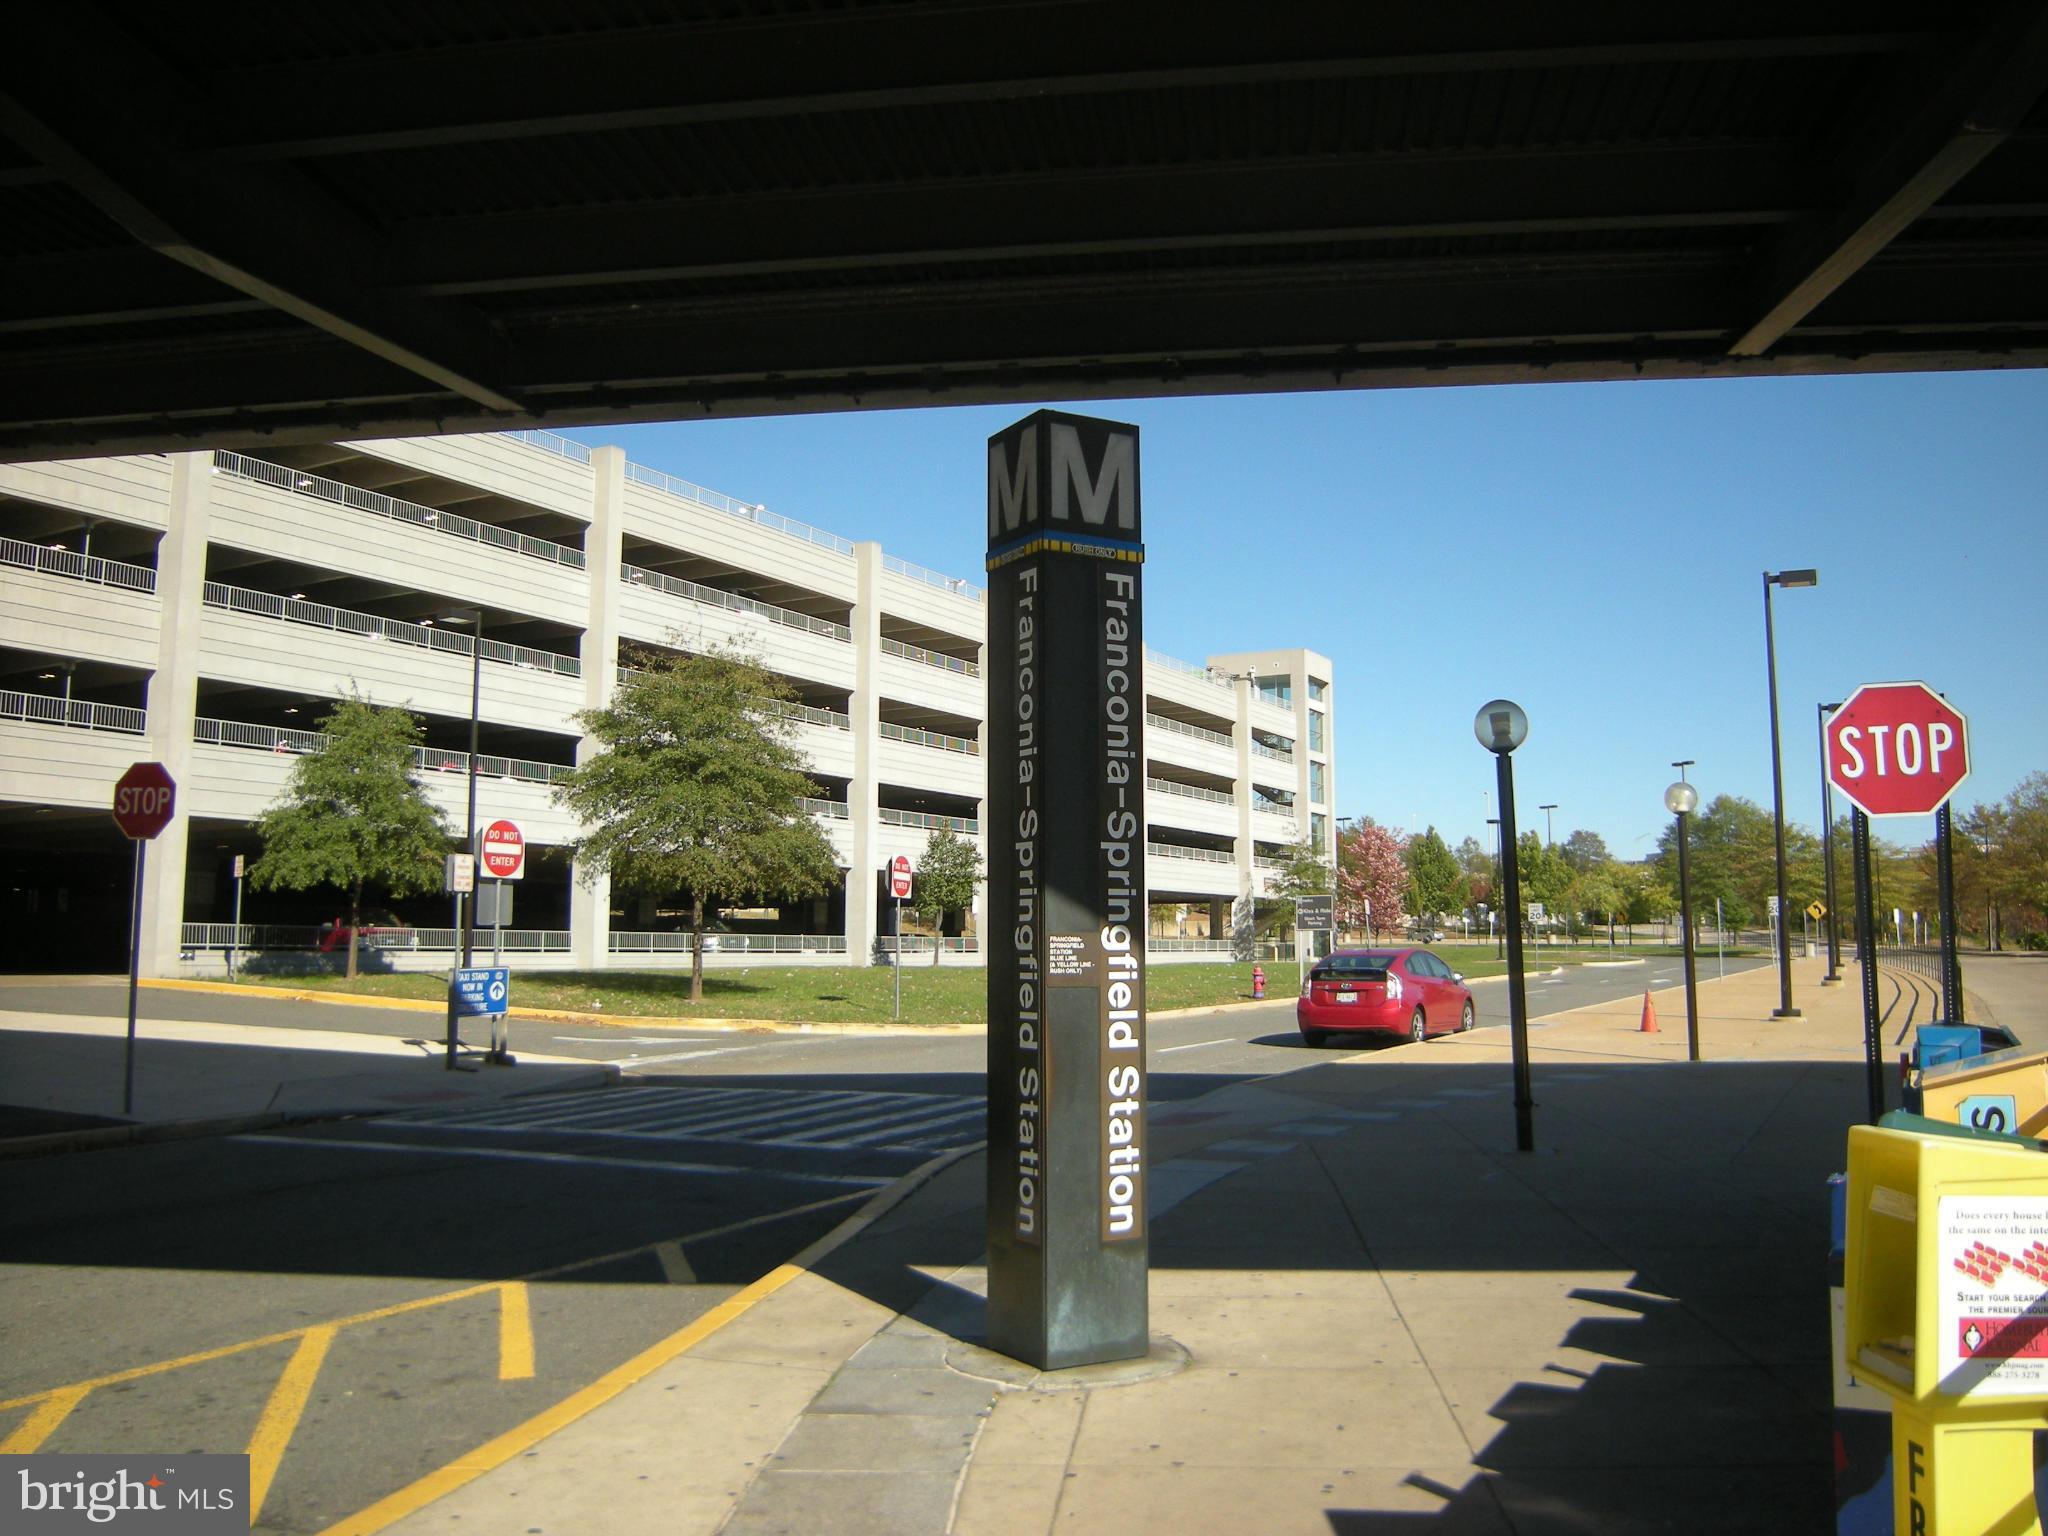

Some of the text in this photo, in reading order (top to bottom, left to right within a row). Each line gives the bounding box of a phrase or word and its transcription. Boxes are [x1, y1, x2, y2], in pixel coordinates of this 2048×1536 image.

[990, 424, 1037, 539] M
[1050, 423, 1135, 529] M
[1838, 722, 1953, 778] STOP
[118, 787, 171, 815] STOP
[489, 830, 518, 841] DO NOT
[491, 856, 515, 867] ENTER
[1015, 567, 1039, 1233] Franconia-Springfield Station
[1101, 572, 1140, 1232] Franconia-Springfield Station
[1530, 912, 1541, 920] 20
[471, 971, 490, 981] STAND
[463, 983, 475, 991] NOW
[1956, 1210, 1980, 1220] Does
[1983, 1212, 2009, 1221] every
[2013, 1211, 2043, 1220] house
[1949, 1226, 1964, 1234] the
[2011, 1226, 2026, 1234] the
